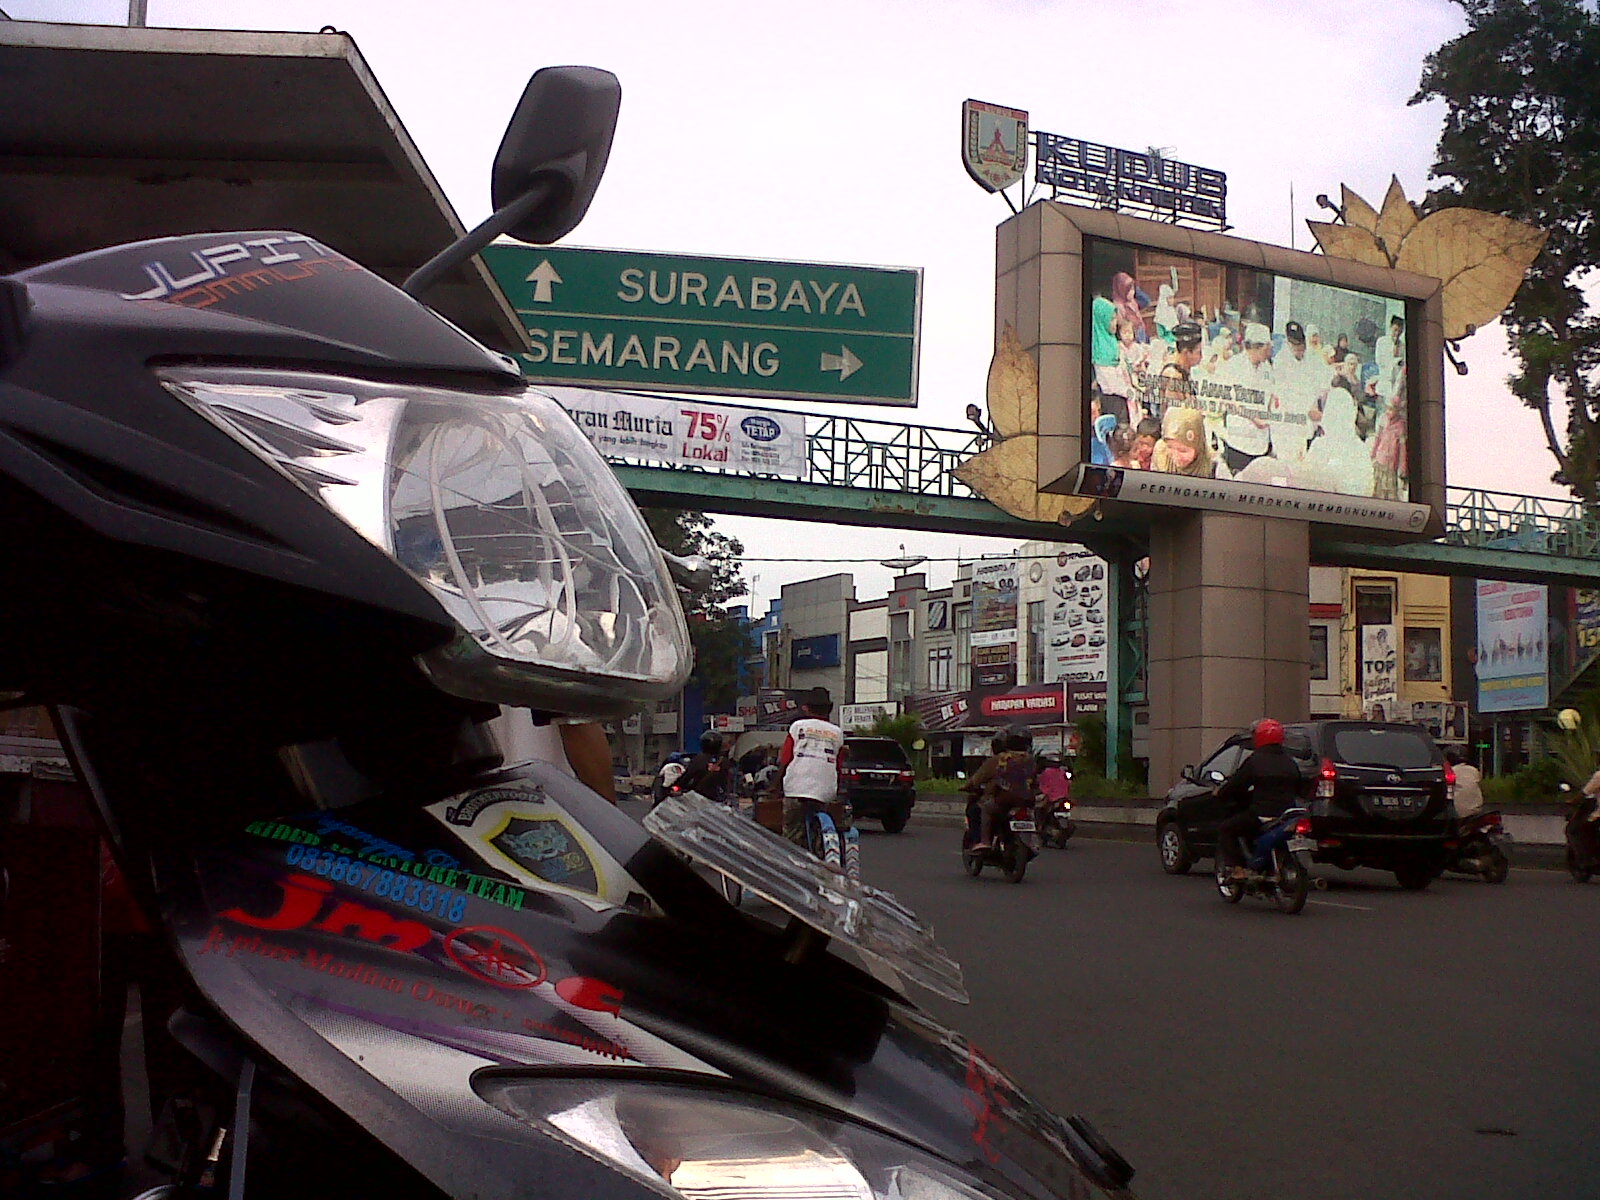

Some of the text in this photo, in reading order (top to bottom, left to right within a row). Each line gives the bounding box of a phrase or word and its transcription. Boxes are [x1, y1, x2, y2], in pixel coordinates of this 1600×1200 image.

[1037, 131, 1226, 198] KUDUS
[617, 268, 866, 318] SURABAYA
[521, 328, 781, 376] SEMARANG
[612, 410, 673, 436] Muria
[680, 410, 731, 442] 75%
[745, 425, 776, 438] TETAP
[682, 442, 728, 462] Lokal
[1238, 493, 1301, 511] MEROKOK
[1364, 660, 1396, 674] TOP
[466, 873, 527, 912] TEAM
